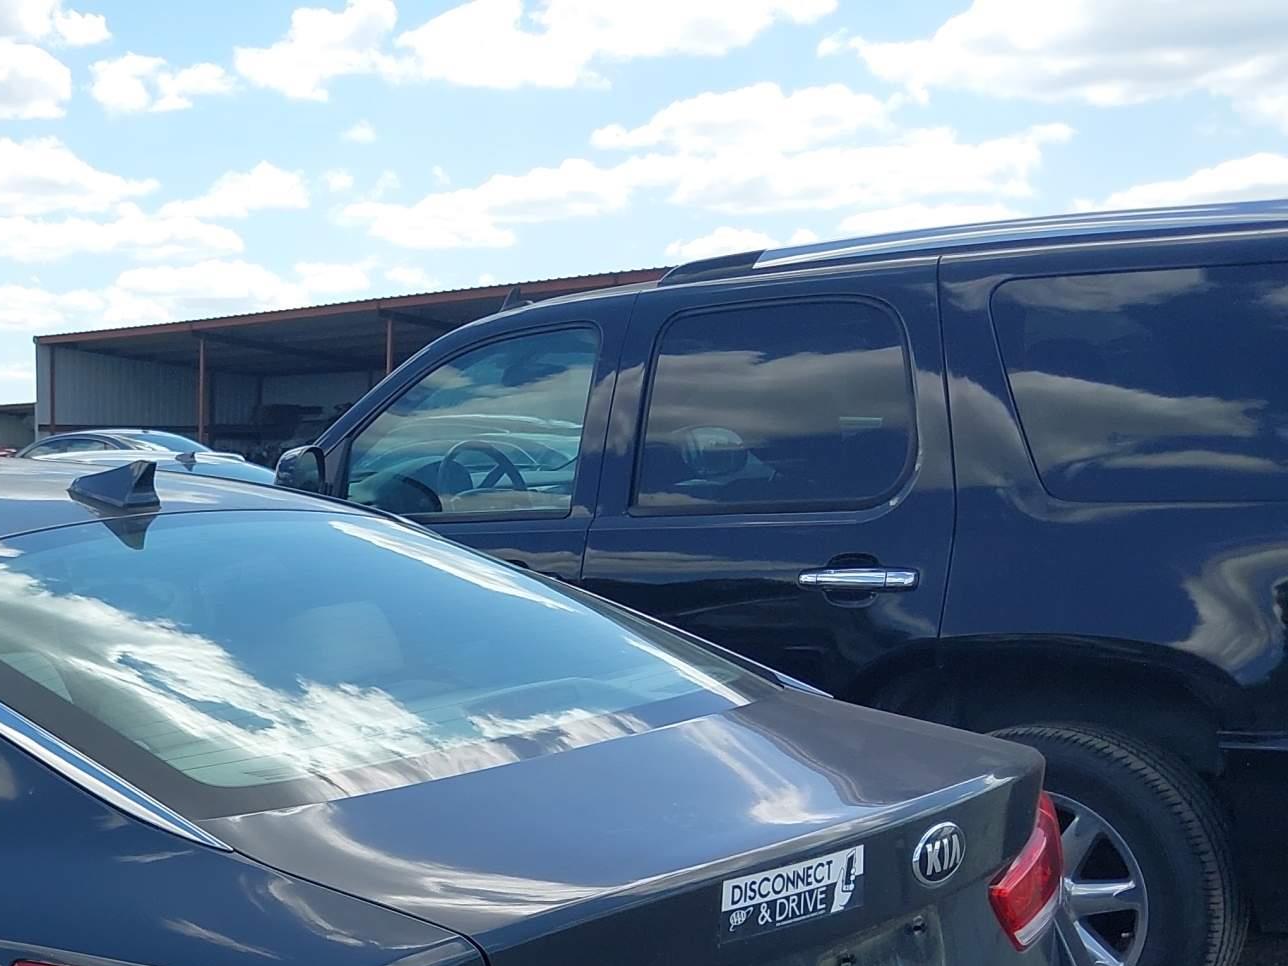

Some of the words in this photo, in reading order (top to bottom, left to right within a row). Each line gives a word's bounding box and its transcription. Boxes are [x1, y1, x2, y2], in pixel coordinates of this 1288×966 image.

[925, 833, 962, 876] KIA
[730, 859, 834, 906] DISCONNECT
[757, 903, 772, 926] &
[775, 887, 827, 922] DRIVE
